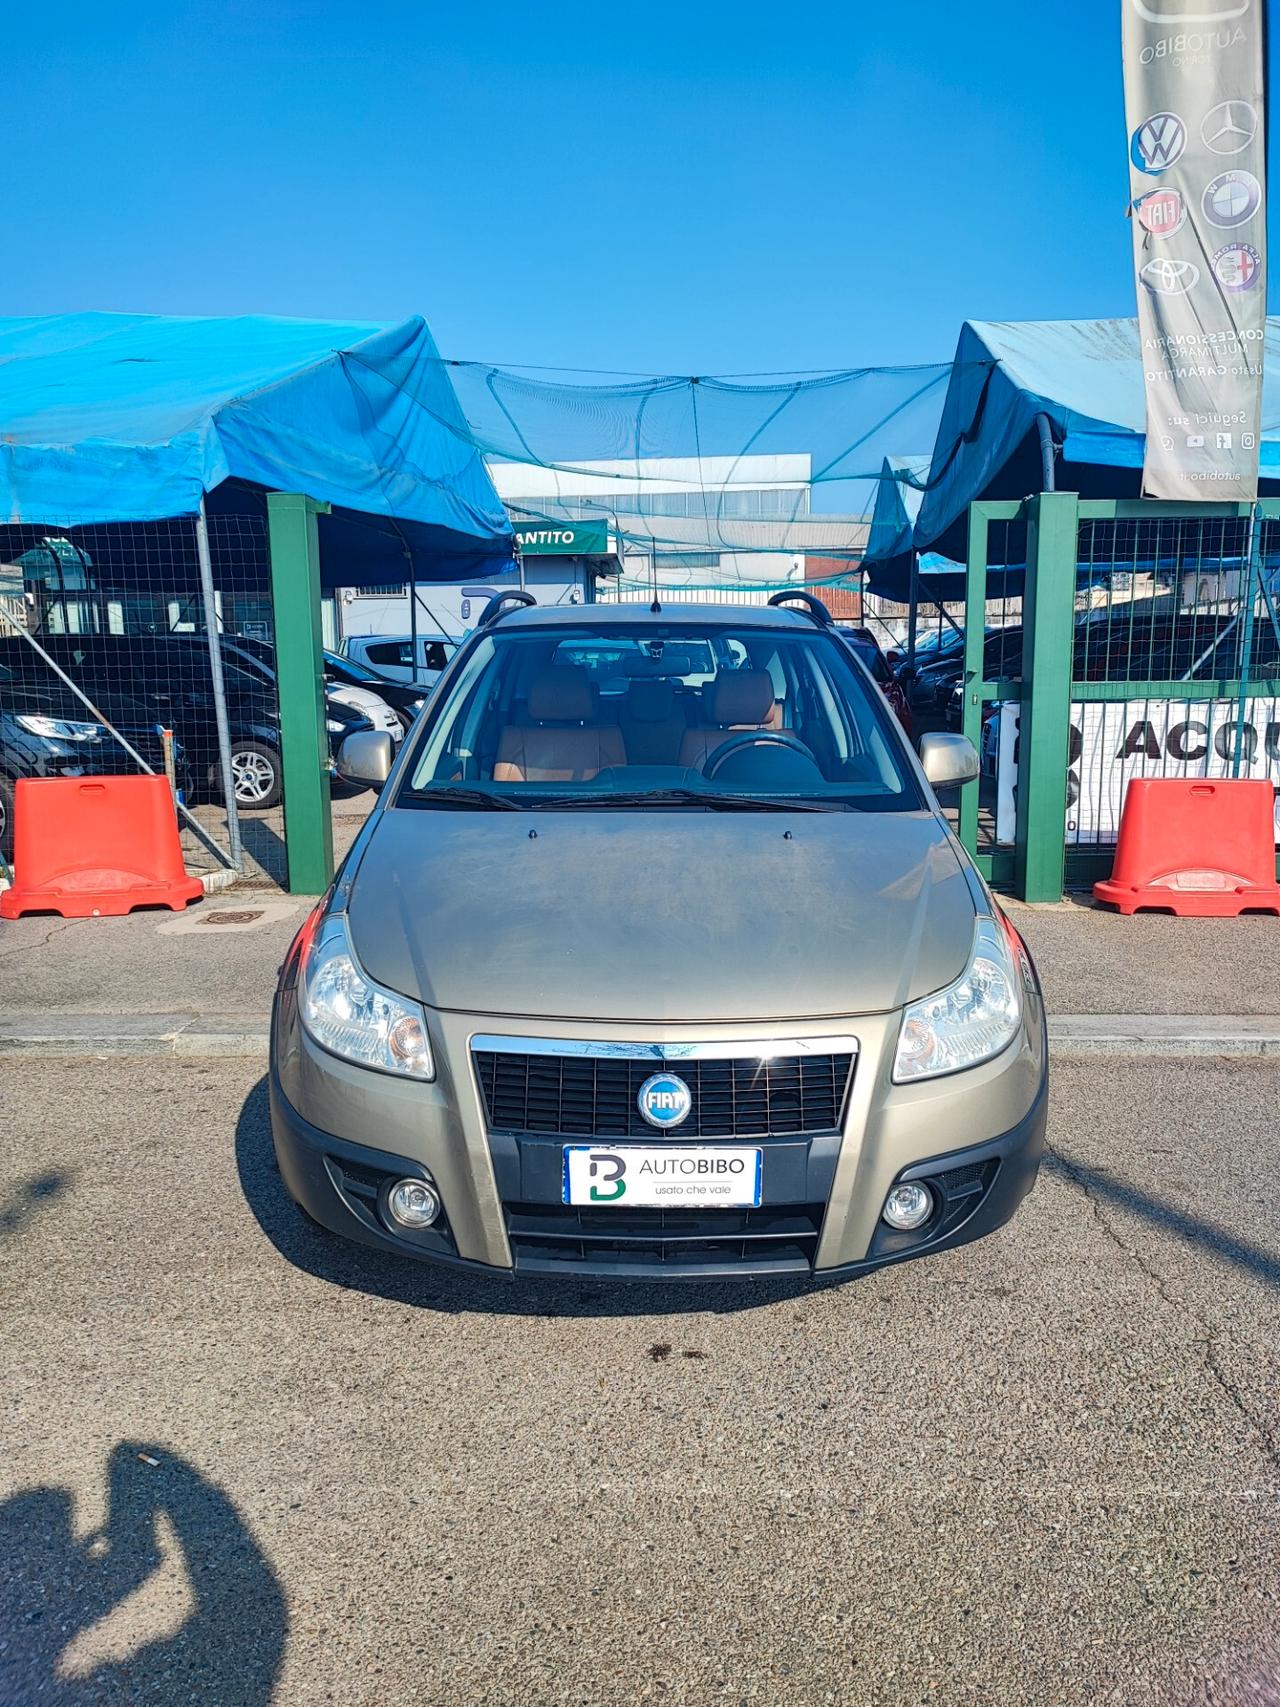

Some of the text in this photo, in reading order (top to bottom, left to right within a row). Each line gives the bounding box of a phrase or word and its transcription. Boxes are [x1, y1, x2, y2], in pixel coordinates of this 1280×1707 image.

[648, 1091, 685, 1109] FIAT
[638, 1158, 745, 1175] AUTOBIBO
[655, 1185, 731, 1195] usato che vale
